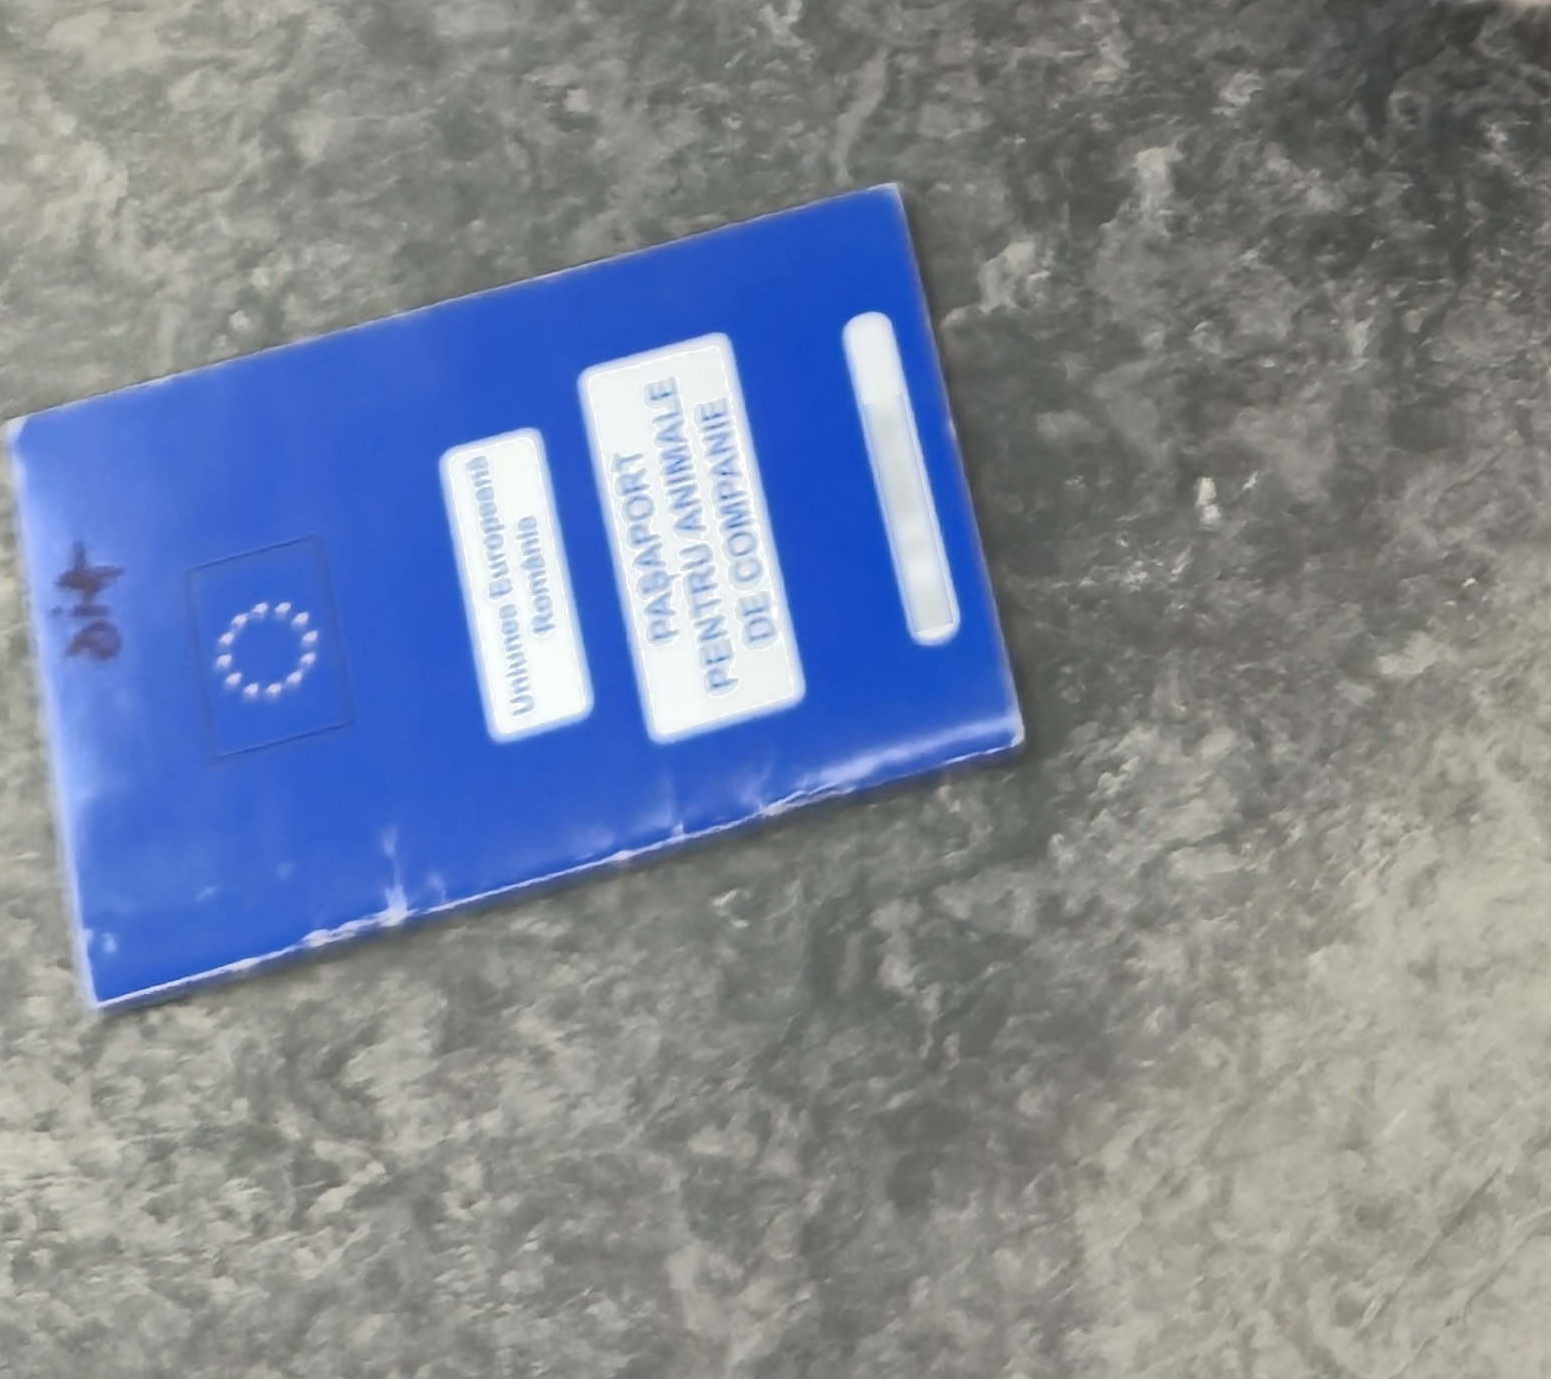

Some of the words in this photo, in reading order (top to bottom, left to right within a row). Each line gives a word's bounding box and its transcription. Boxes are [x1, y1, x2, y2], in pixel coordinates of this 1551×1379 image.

[647, 376, 707, 539] ANIMALE
[696, 398, 764, 589] COMPANIE
[515, 515, 556, 636] România
[680, 543, 739, 695] PENTRU
[740, 591, 776, 647] DE
[499, 604, 535, 716] Uniunea
